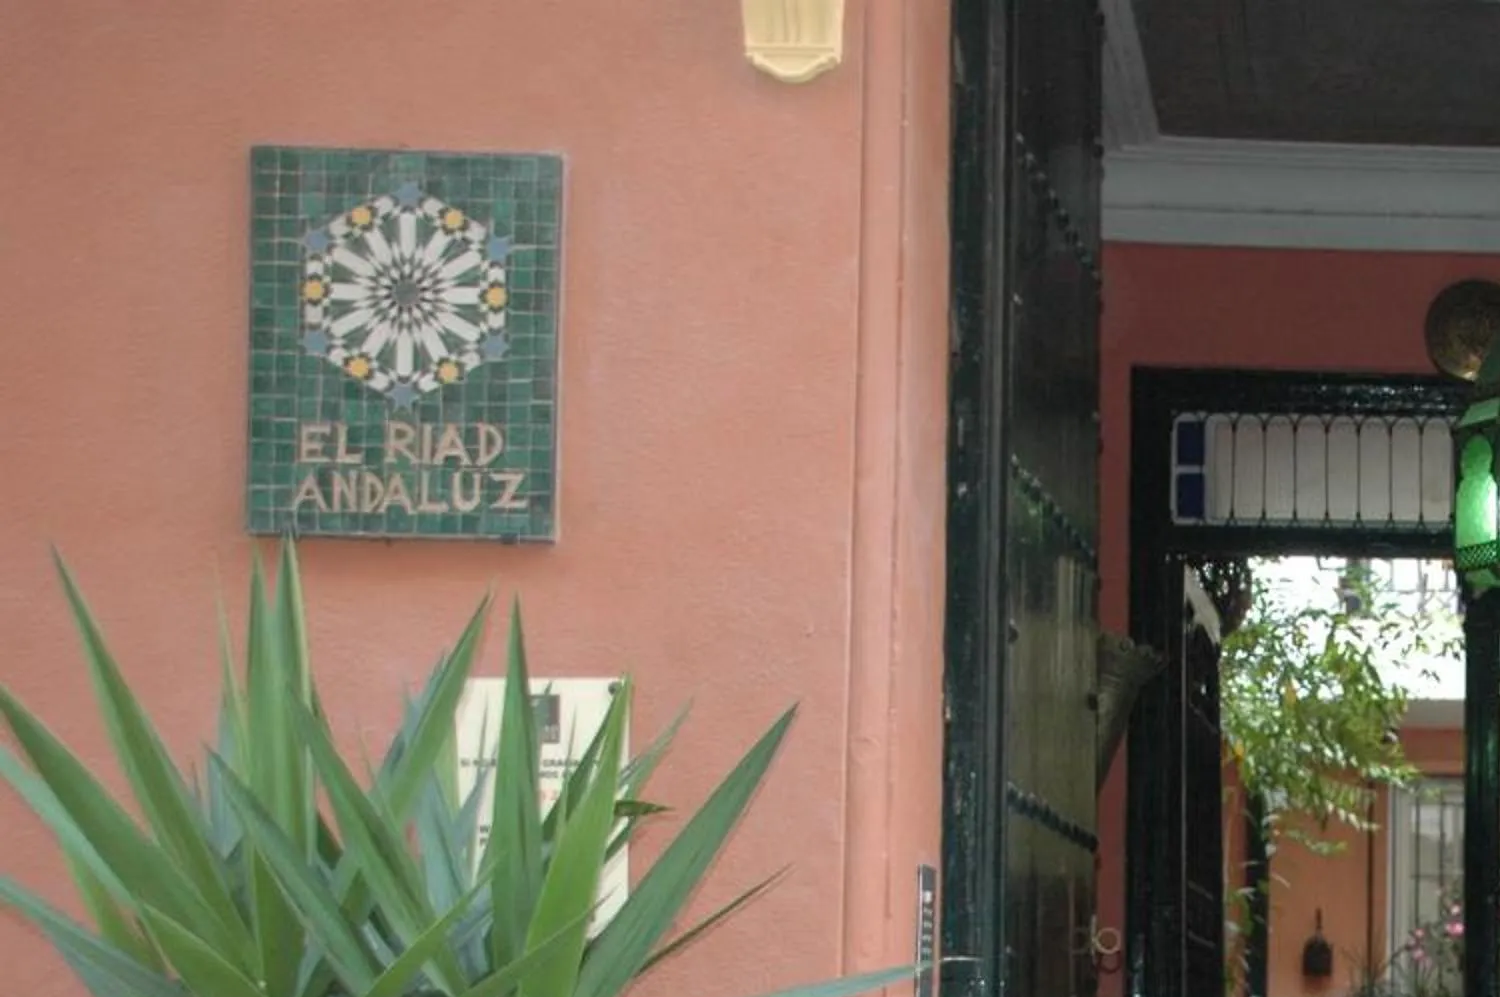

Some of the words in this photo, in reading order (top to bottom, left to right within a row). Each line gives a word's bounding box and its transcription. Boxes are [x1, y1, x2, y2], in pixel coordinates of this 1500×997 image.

[298, 420, 363, 464] EL
[383, 418, 505, 467] RIAD
[291, 469, 529, 516] ANDALUZ
